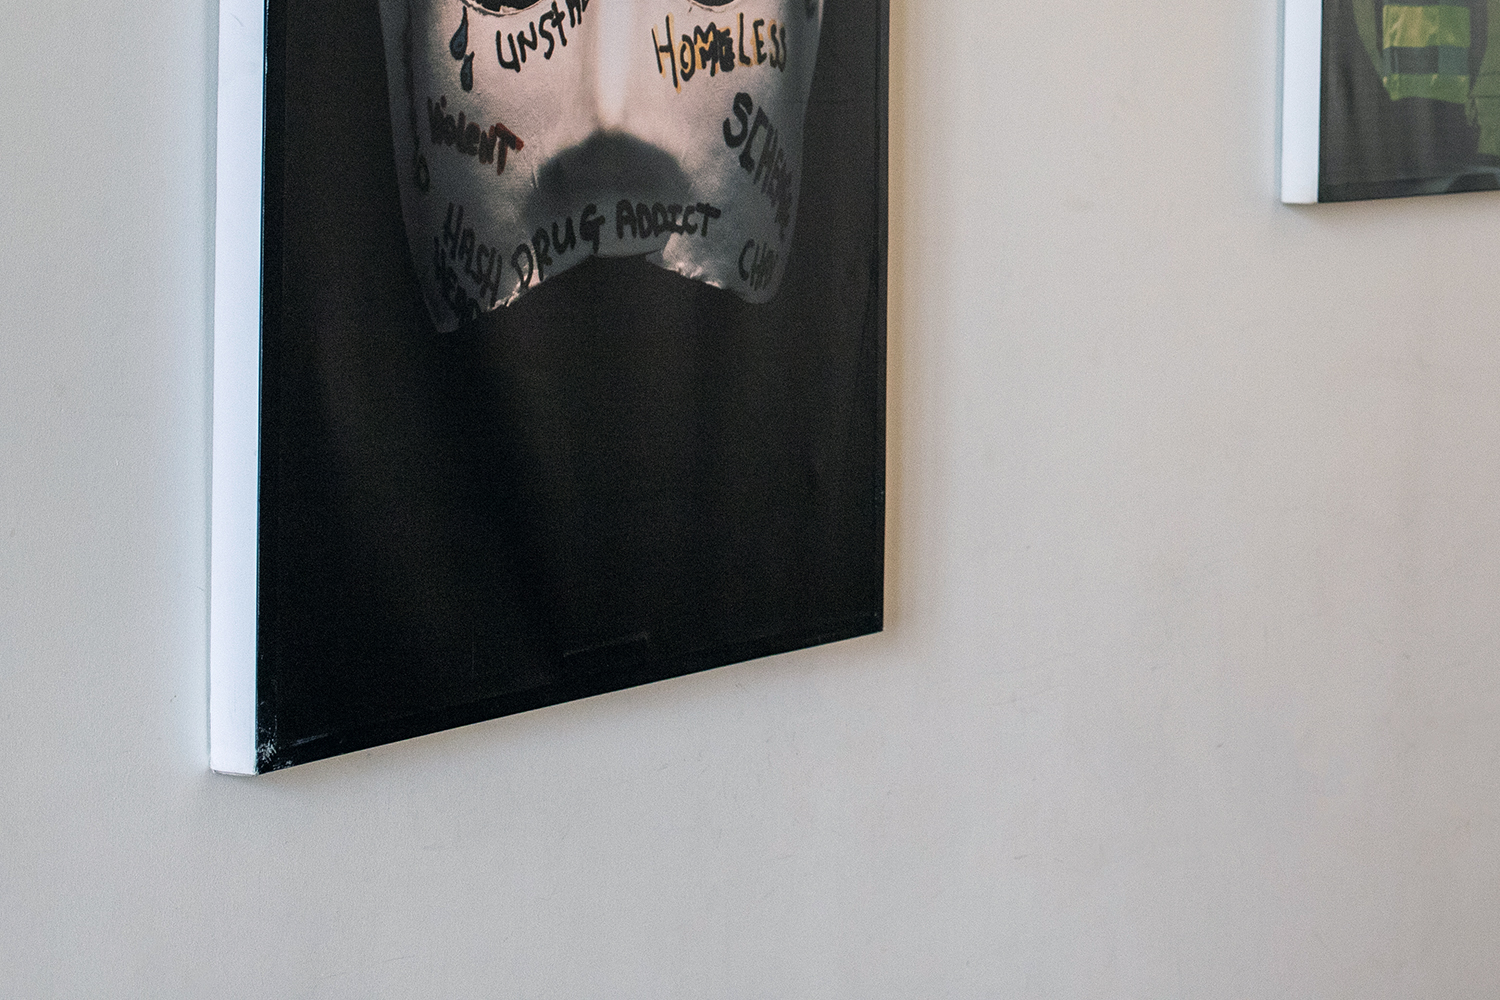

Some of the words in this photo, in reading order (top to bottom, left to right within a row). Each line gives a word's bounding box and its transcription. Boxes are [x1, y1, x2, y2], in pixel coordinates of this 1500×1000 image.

[651, 12, 787, 93] HOMELESS
[511, 203, 606, 288] DRUG
[615, 199, 721, 239] ADDICT
